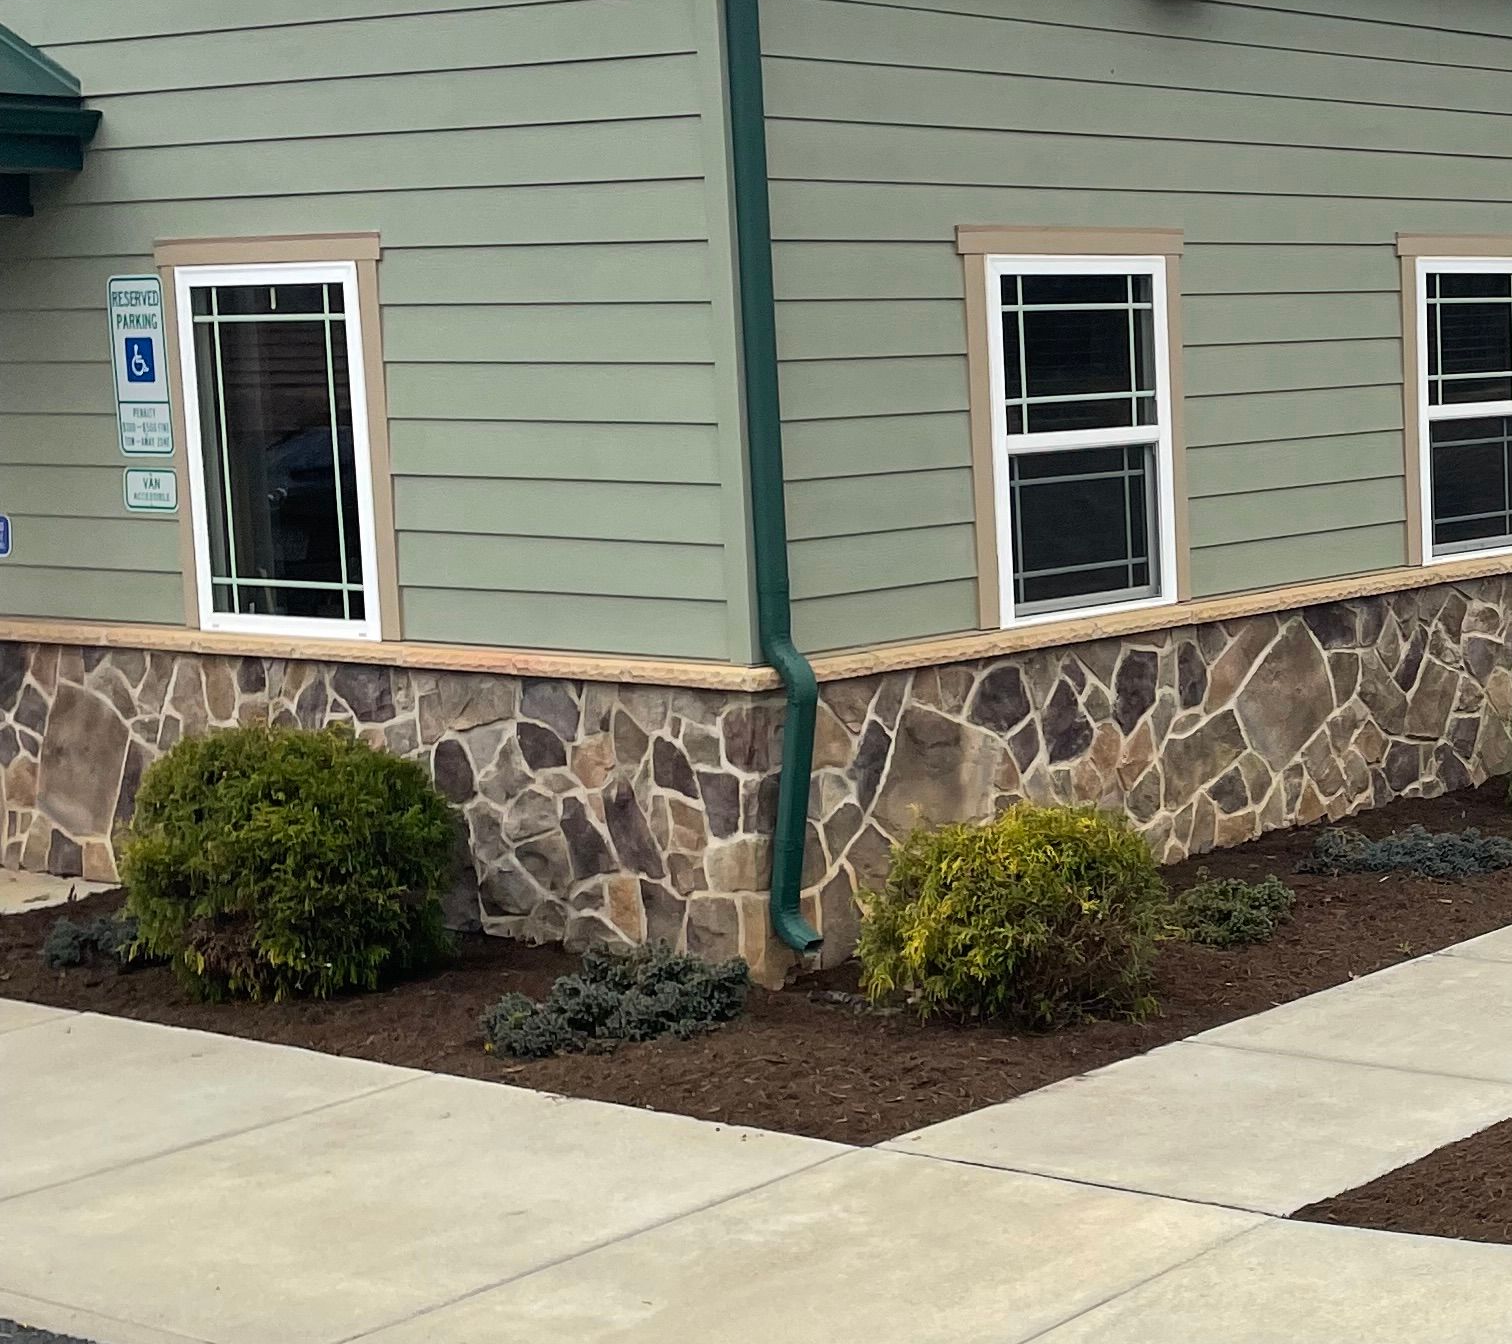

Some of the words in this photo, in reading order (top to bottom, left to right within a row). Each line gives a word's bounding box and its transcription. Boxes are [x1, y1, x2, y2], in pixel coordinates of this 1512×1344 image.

[111, 290, 160, 307] RESERVED
[116, 313, 158, 329] PARKING
[142, 477, 161, 490] VAN
